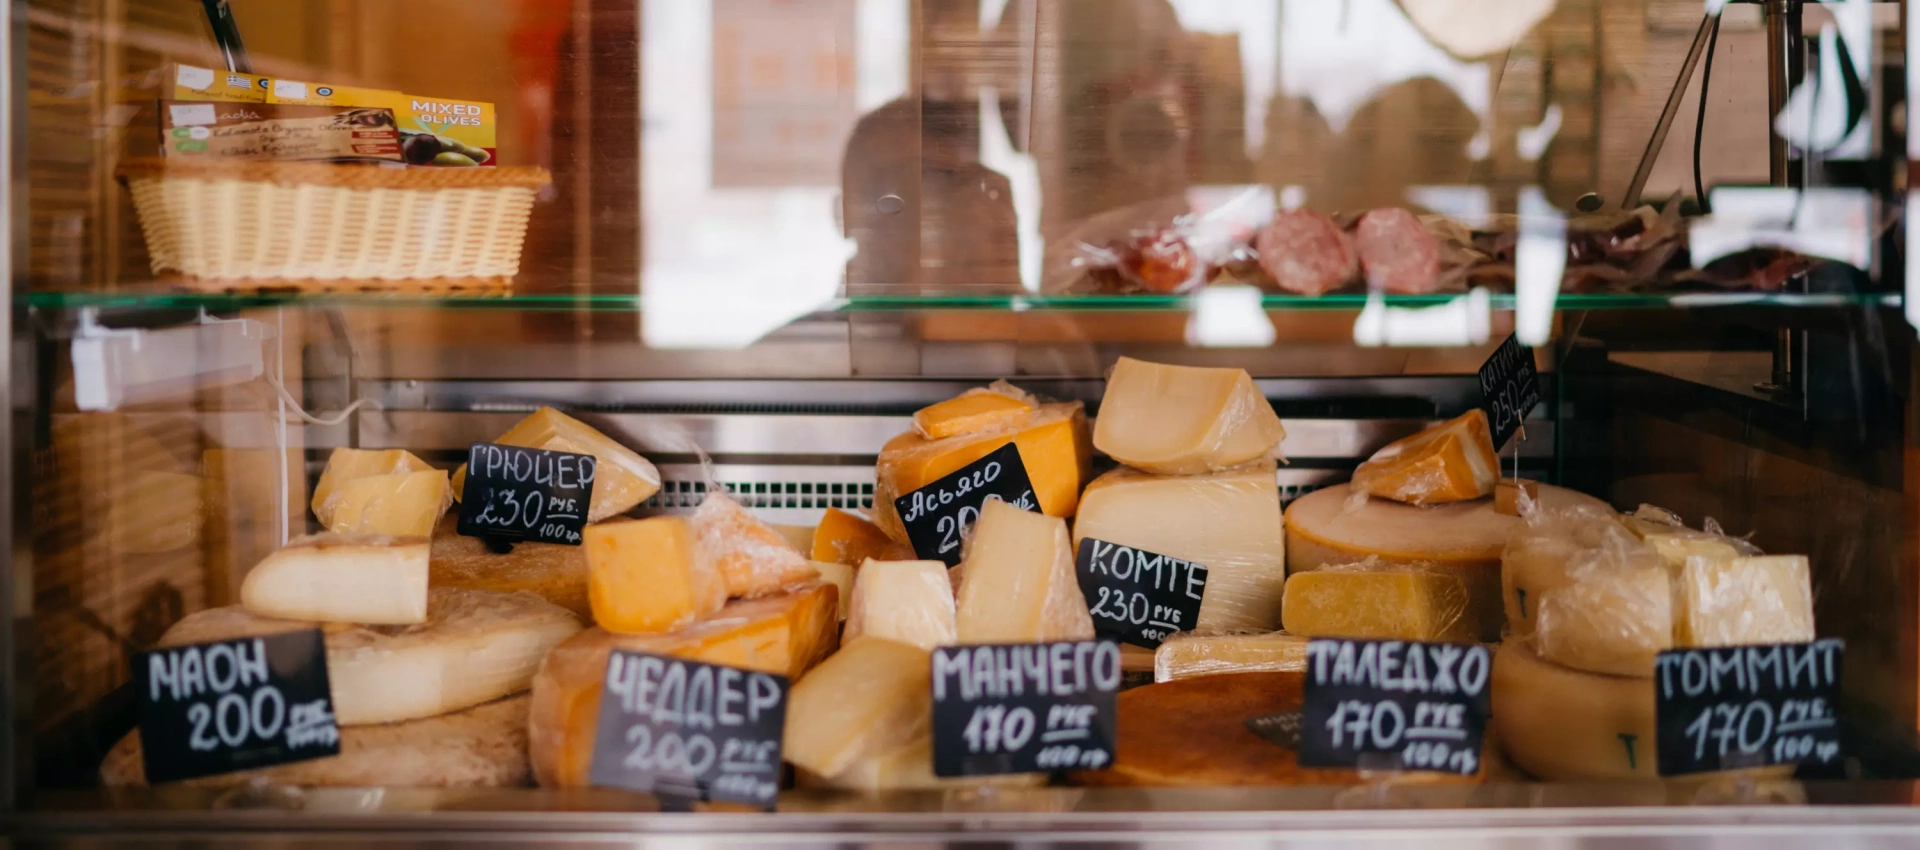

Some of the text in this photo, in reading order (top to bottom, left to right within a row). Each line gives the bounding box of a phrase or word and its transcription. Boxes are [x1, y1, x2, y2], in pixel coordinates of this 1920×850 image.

[411, 99, 482, 116] MIXED
[420, 113, 482, 126] OLIVES
[1492, 379, 1520, 436] 250
[470, 445, 597, 489] ГРЮЙЕР
[904, 461, 1001, 522] Асьяго
[539, 523, 565, 539] 100
[936, 493, 1003, 554] 20
[1090, 539, 1208, 600] КОМТЕ
[1090, 586, 1182, 625] 230 РУБ
[606, 652, 782, 731] ЧЕДДЕР
[933, 640, 1121, 701] МАНЧЕГО
[1307, 639, 1489, 697] ТАЛЕДЖО
[1655, 638, 1845, 700] ТОММИТ
[187, 686, 285, 751] 200
[963, 704, 1035, 753] 170
[1326, 699, 1405, 749] 170
[1685, 700, 1773, 761] 170
[623, 724, 716, 776] 200
[1403, 741, 1449, 768] 100
[1773, 735, 1815, 763] 100
